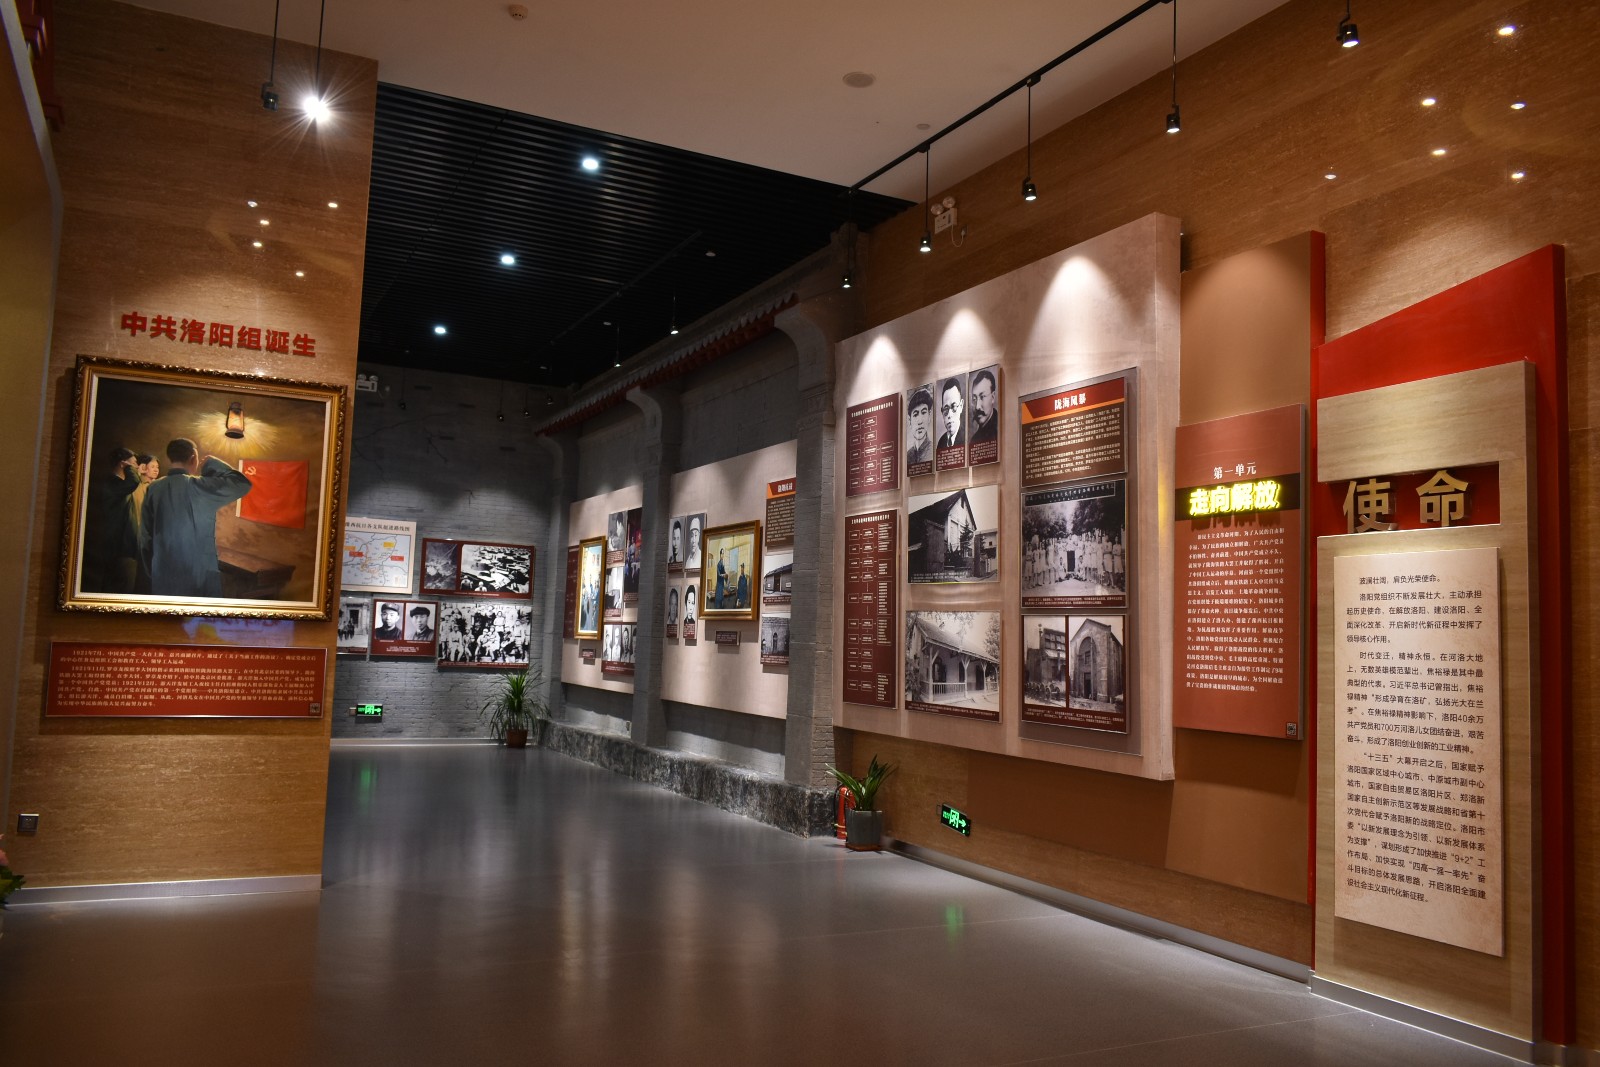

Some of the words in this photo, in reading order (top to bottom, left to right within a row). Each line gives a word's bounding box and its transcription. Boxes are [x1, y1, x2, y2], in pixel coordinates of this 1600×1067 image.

[121, 311, 316, 357] 中共洛阳组诞生
[1054, 393, 1086, 410] 陇海风暴
[1214, 462, 1256, 479] 第一单元
[1190, 480, 1280, 516] 走向解放
[1342, 469, 1469, 534] 使命
[1346, 635, 1391, 644] 领导核心作用。
